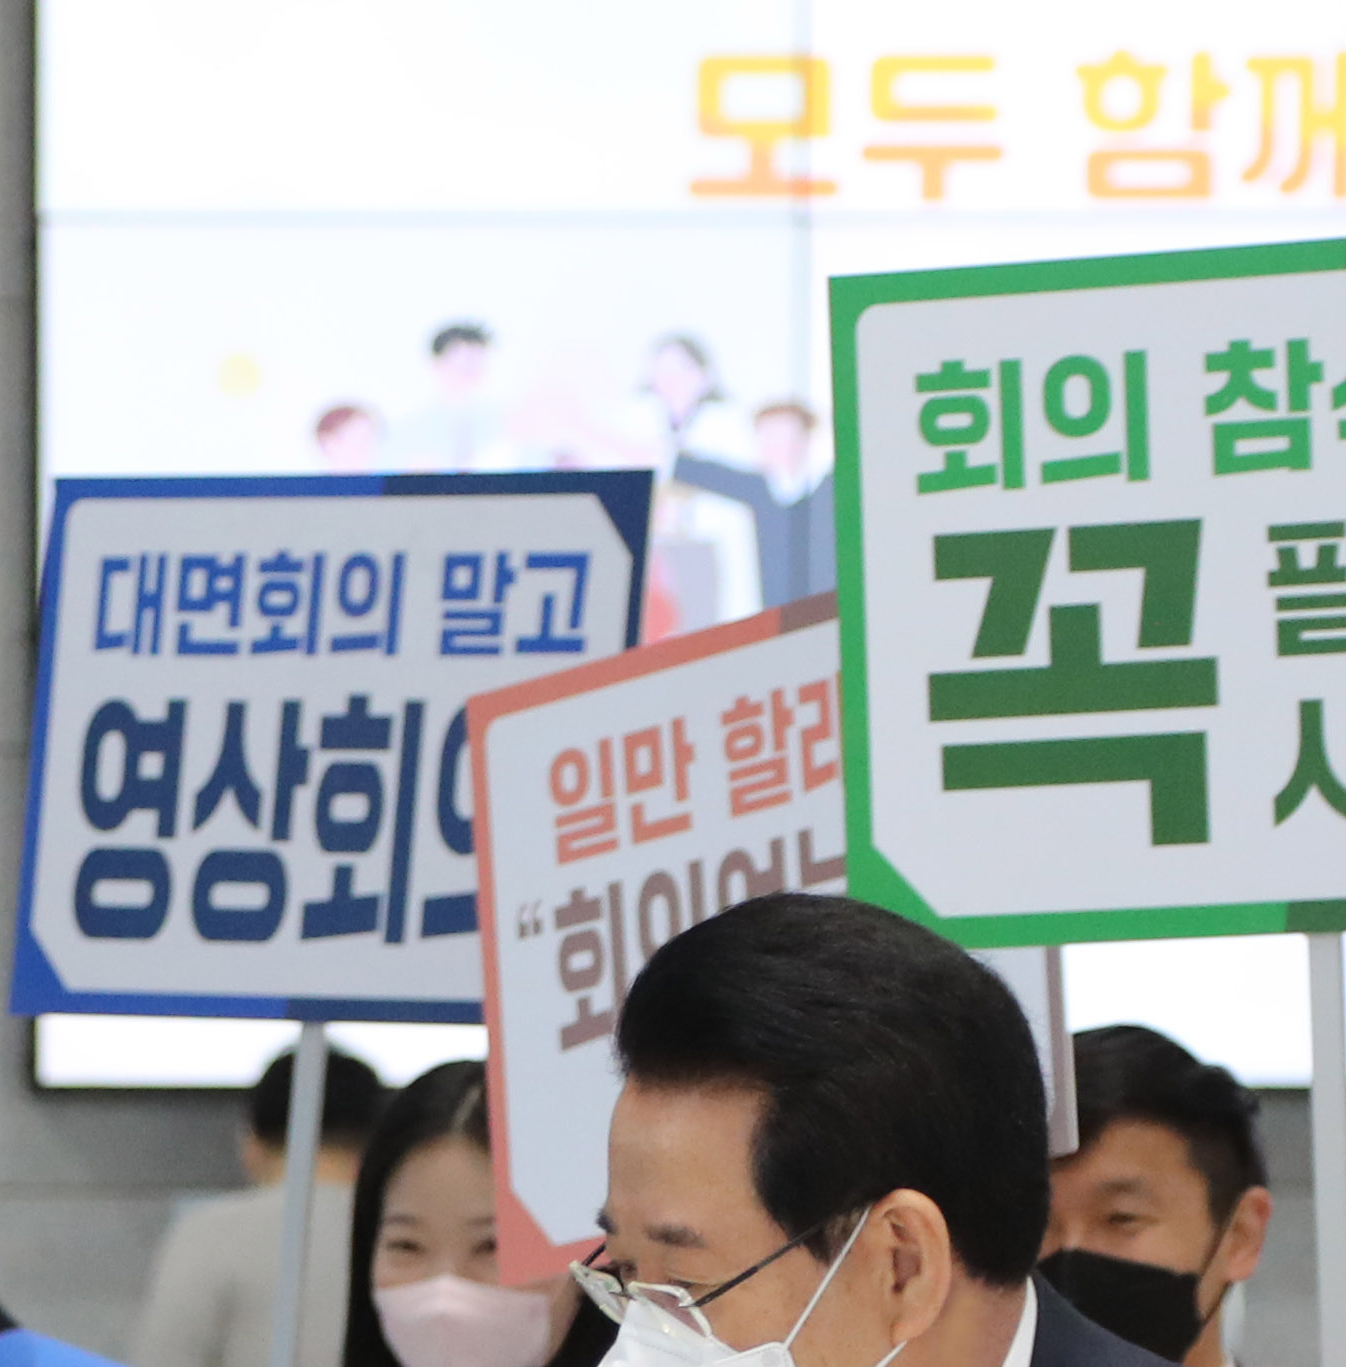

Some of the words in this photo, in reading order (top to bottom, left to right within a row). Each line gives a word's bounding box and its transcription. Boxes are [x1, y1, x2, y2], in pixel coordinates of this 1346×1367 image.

[687, 53, 1006, 202] 모두
[913, 348, 1151, 495] 회의
[93, 549, 409, 658] 대면회의
[435, 549, 591, 658] 말고
[926, 517, 1220, 848] 꼭
[548, 715, 696, 866] 일만
